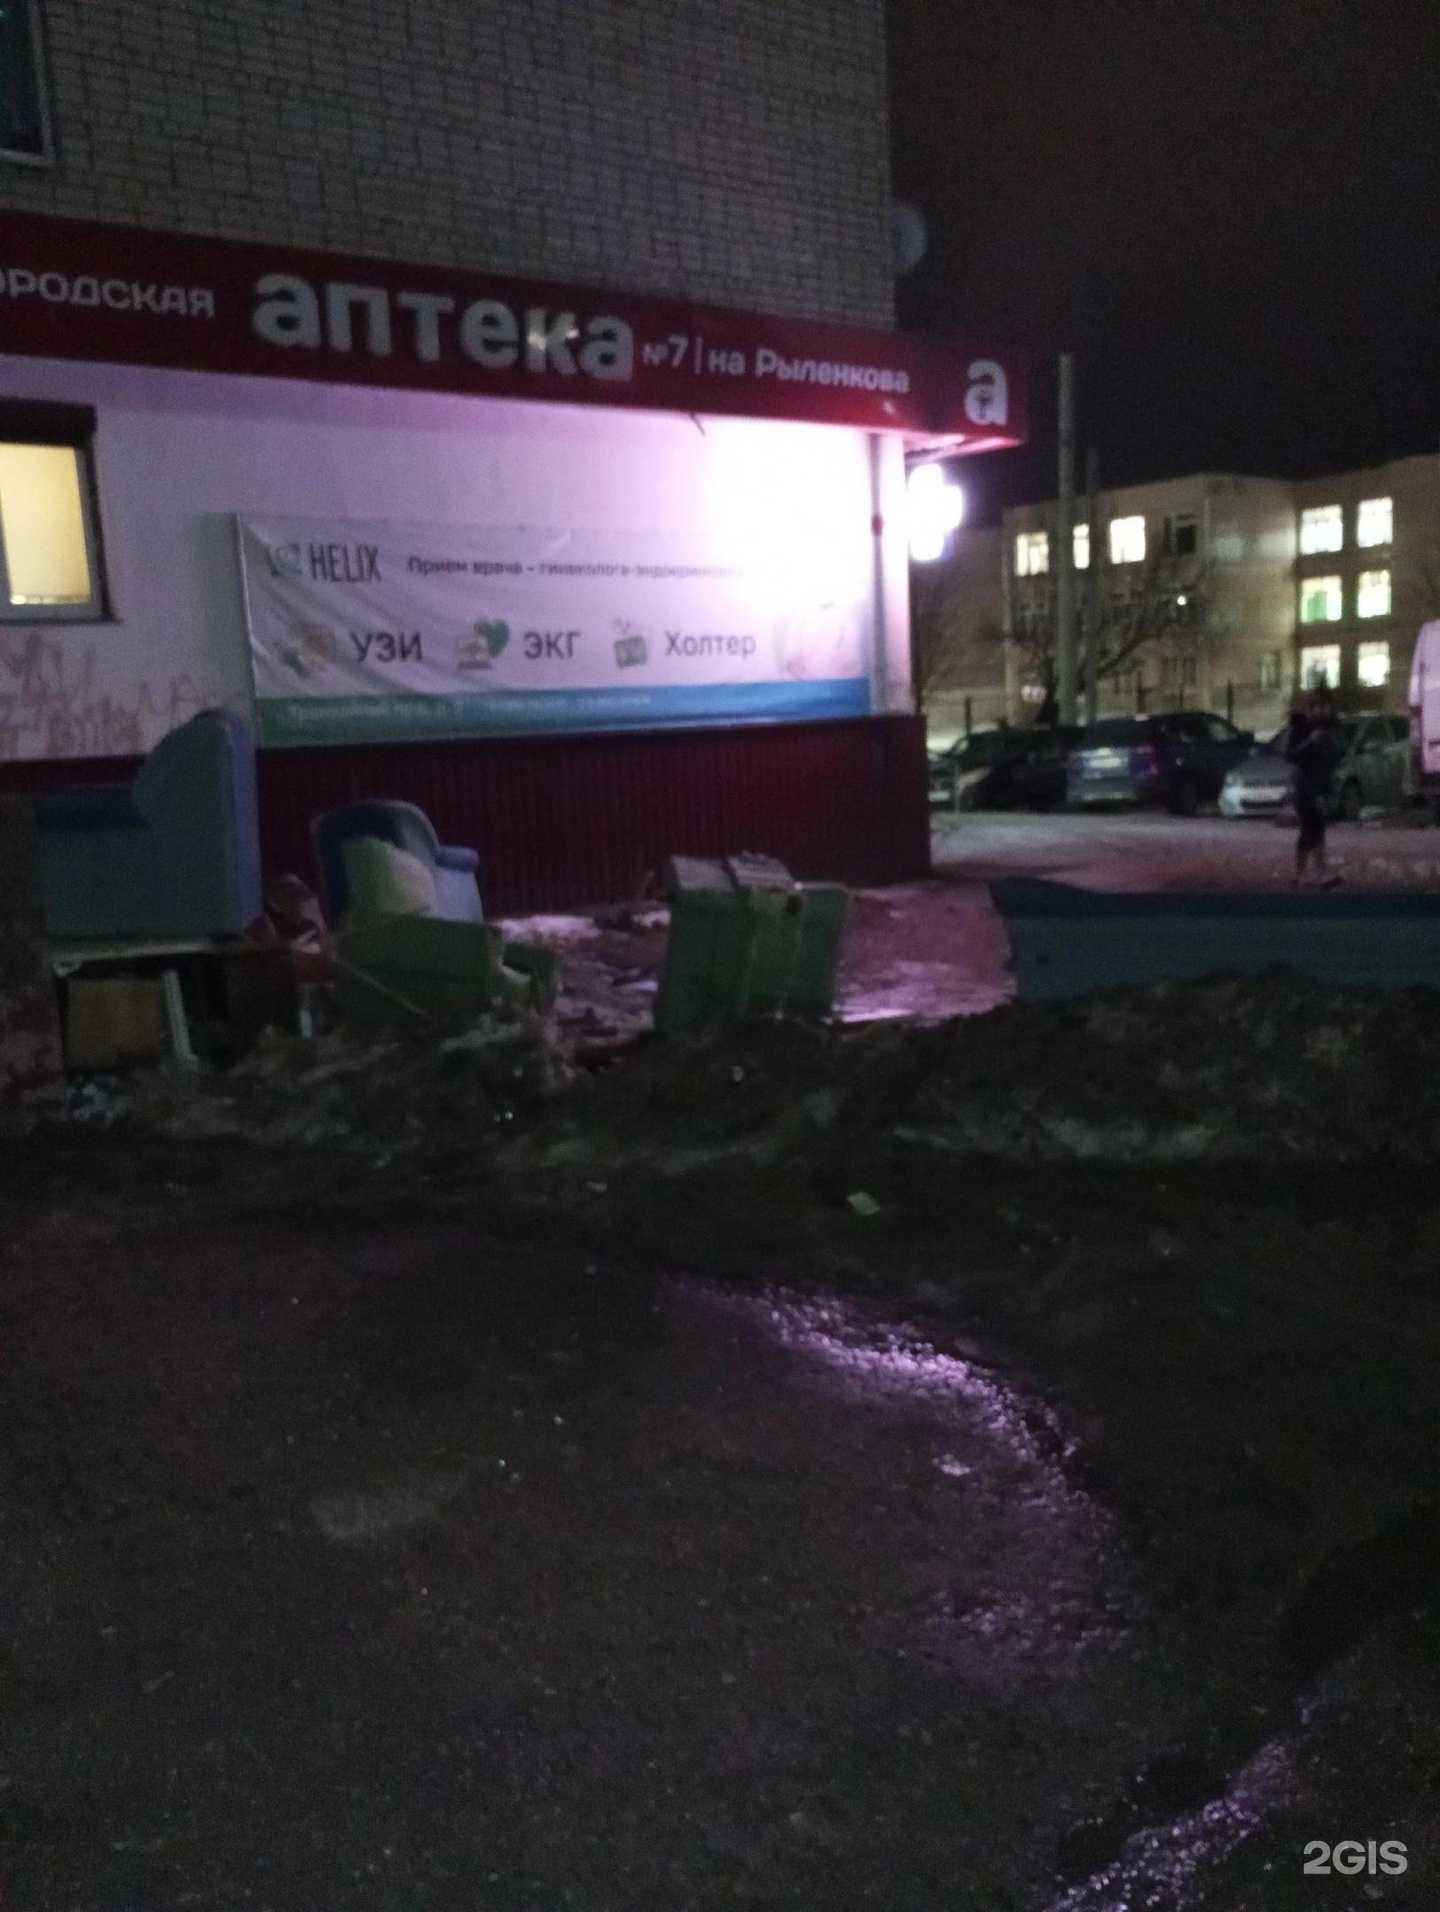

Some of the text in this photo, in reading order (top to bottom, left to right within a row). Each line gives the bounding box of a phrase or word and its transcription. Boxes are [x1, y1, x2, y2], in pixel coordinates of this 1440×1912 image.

[0, 267, 215, 318] РОДСКАЯ
[252, 271, 635, 383] аптека
[707, 348, 747, 376] на
[754, 347, 911, 394] Рыленкова
[308, 542, 383, 584] HELIX
[350, 631, 758, 663] УЗИ ЭКГ Холтер
